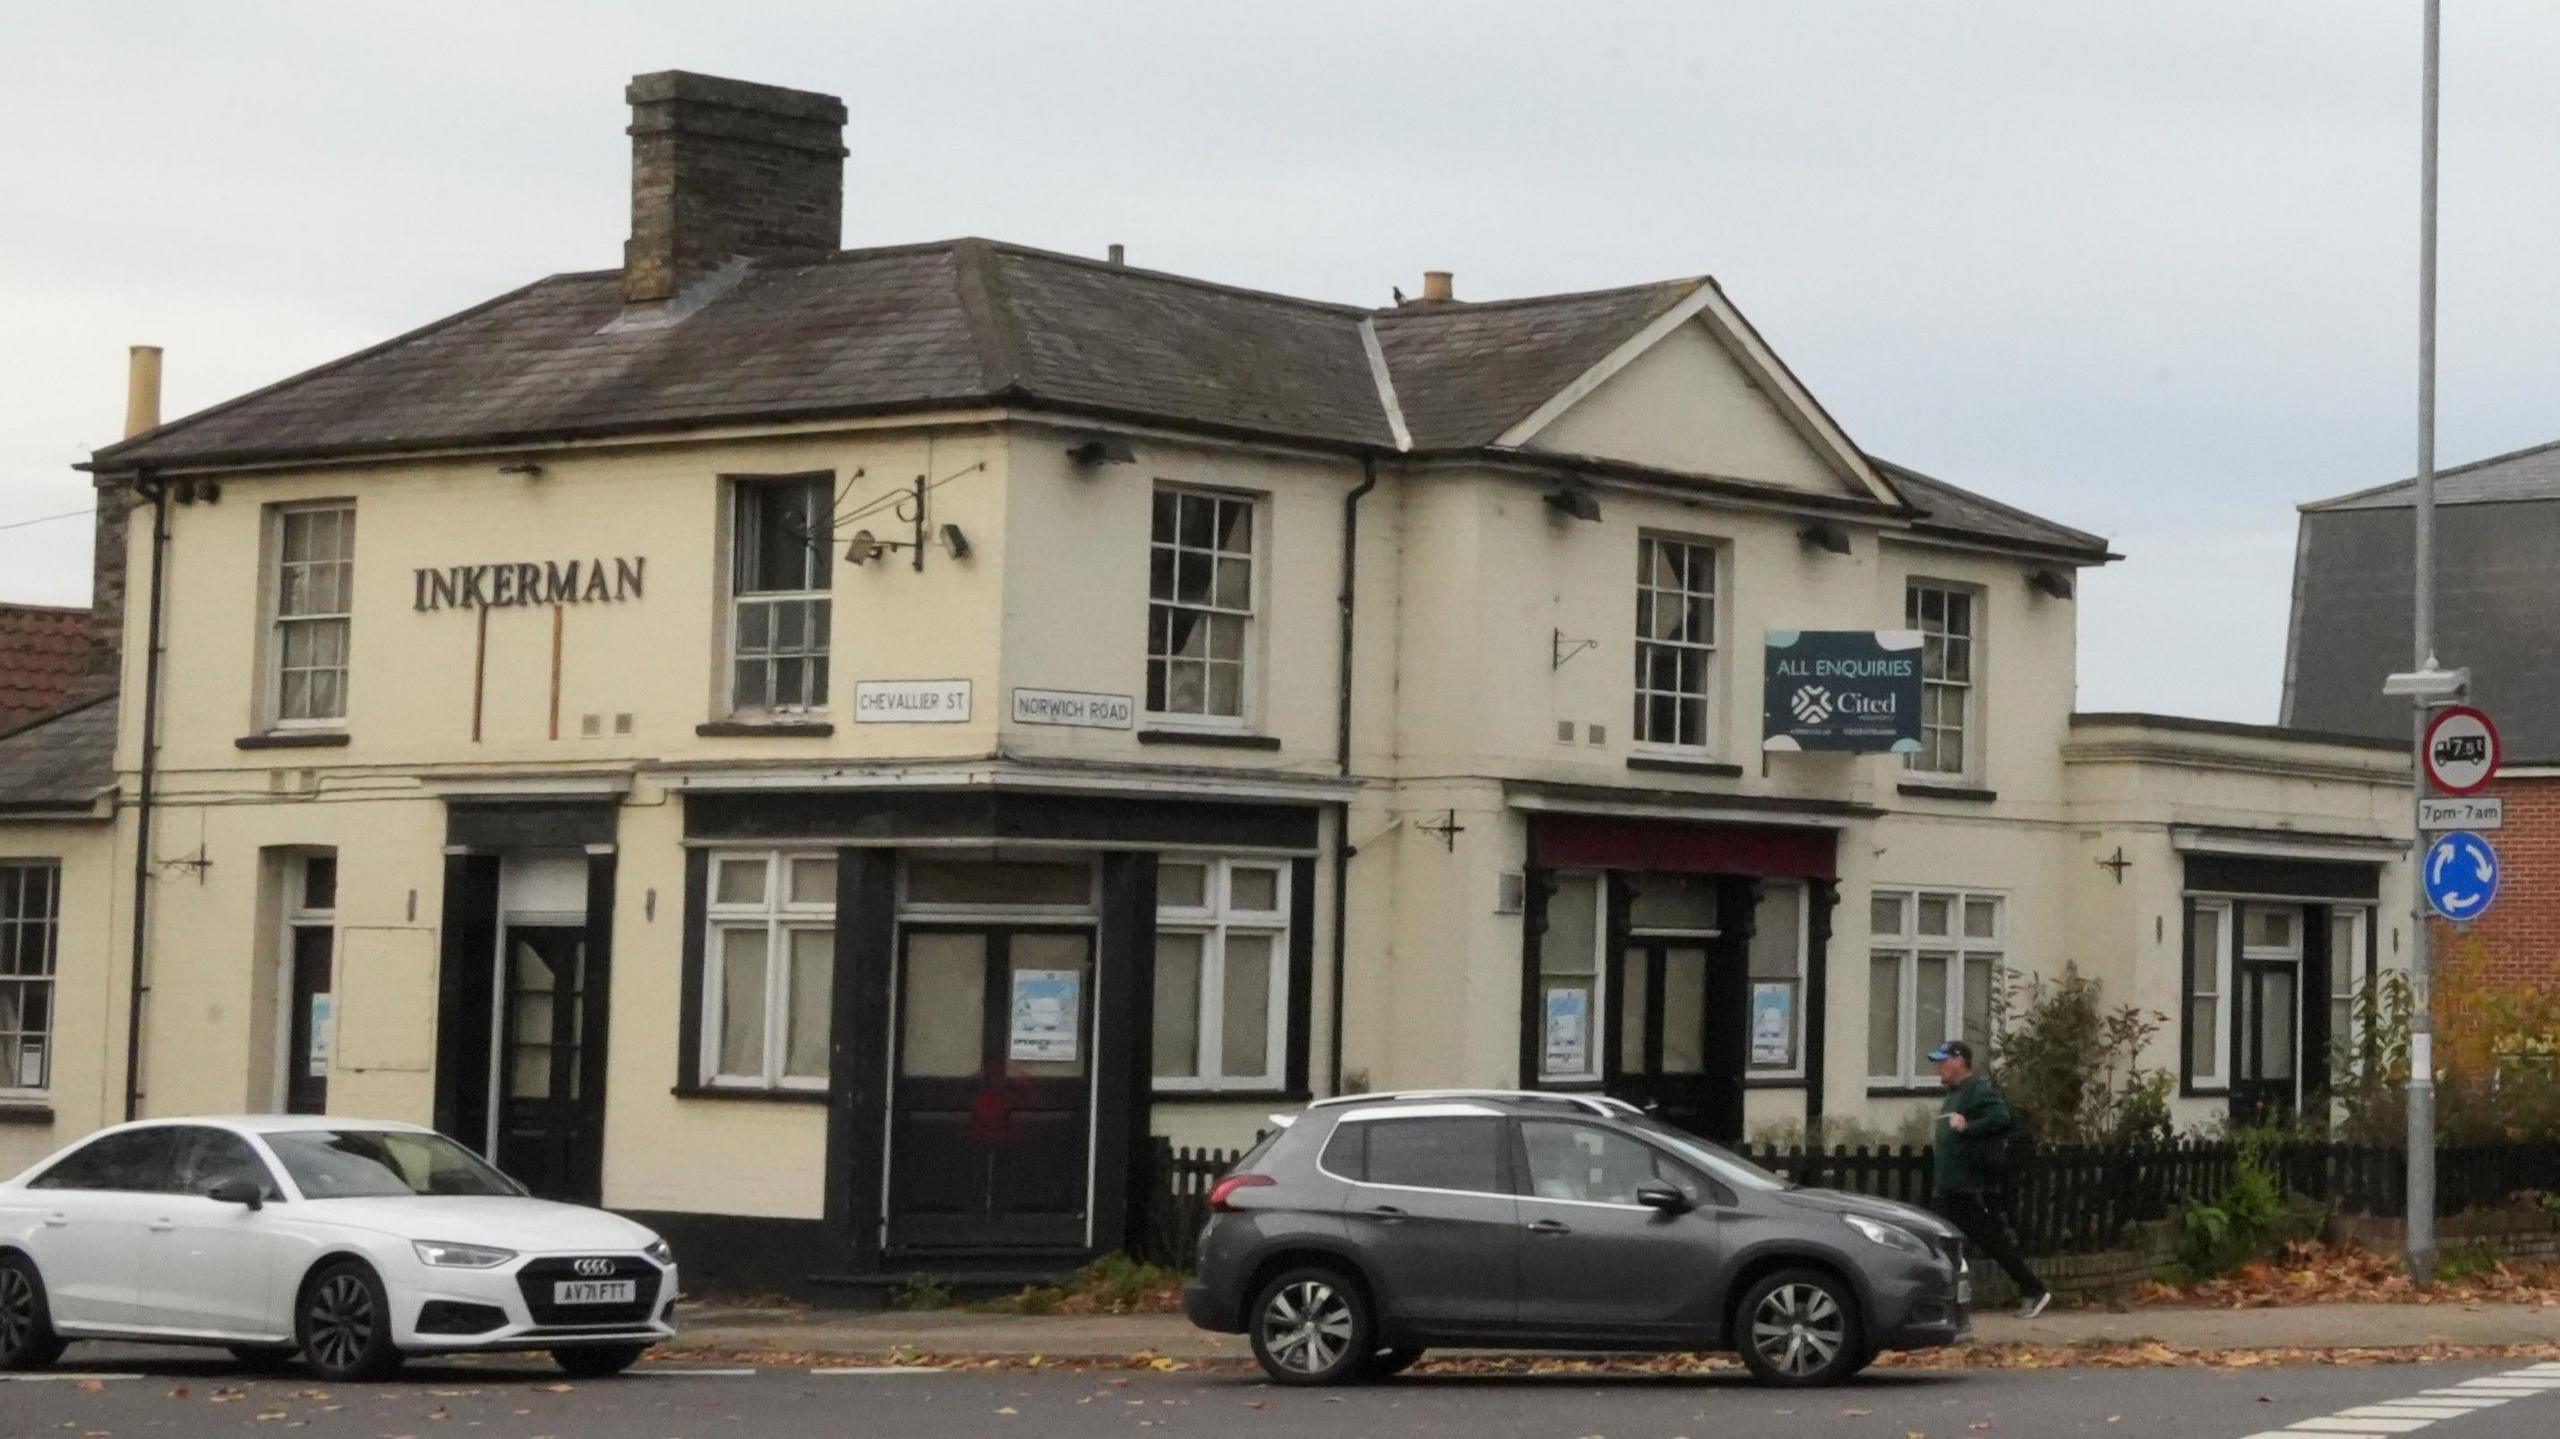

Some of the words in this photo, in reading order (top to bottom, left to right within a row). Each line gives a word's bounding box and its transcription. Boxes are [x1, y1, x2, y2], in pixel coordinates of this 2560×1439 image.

[413, 556, 646, 612] INKERMAN
[1777, 659, 1810, 676] ALL
[1816, 659, 1912, 678] ENQUIRIES
[860, 692, 940, 711] CHEVALLIER
[947, 692, 964, 710] ST
[1019, 698, 1084, 718] NORWICH
[1089, 702, 1129, 721] ROAD
[1837, 692, 1896, 713] Cited
